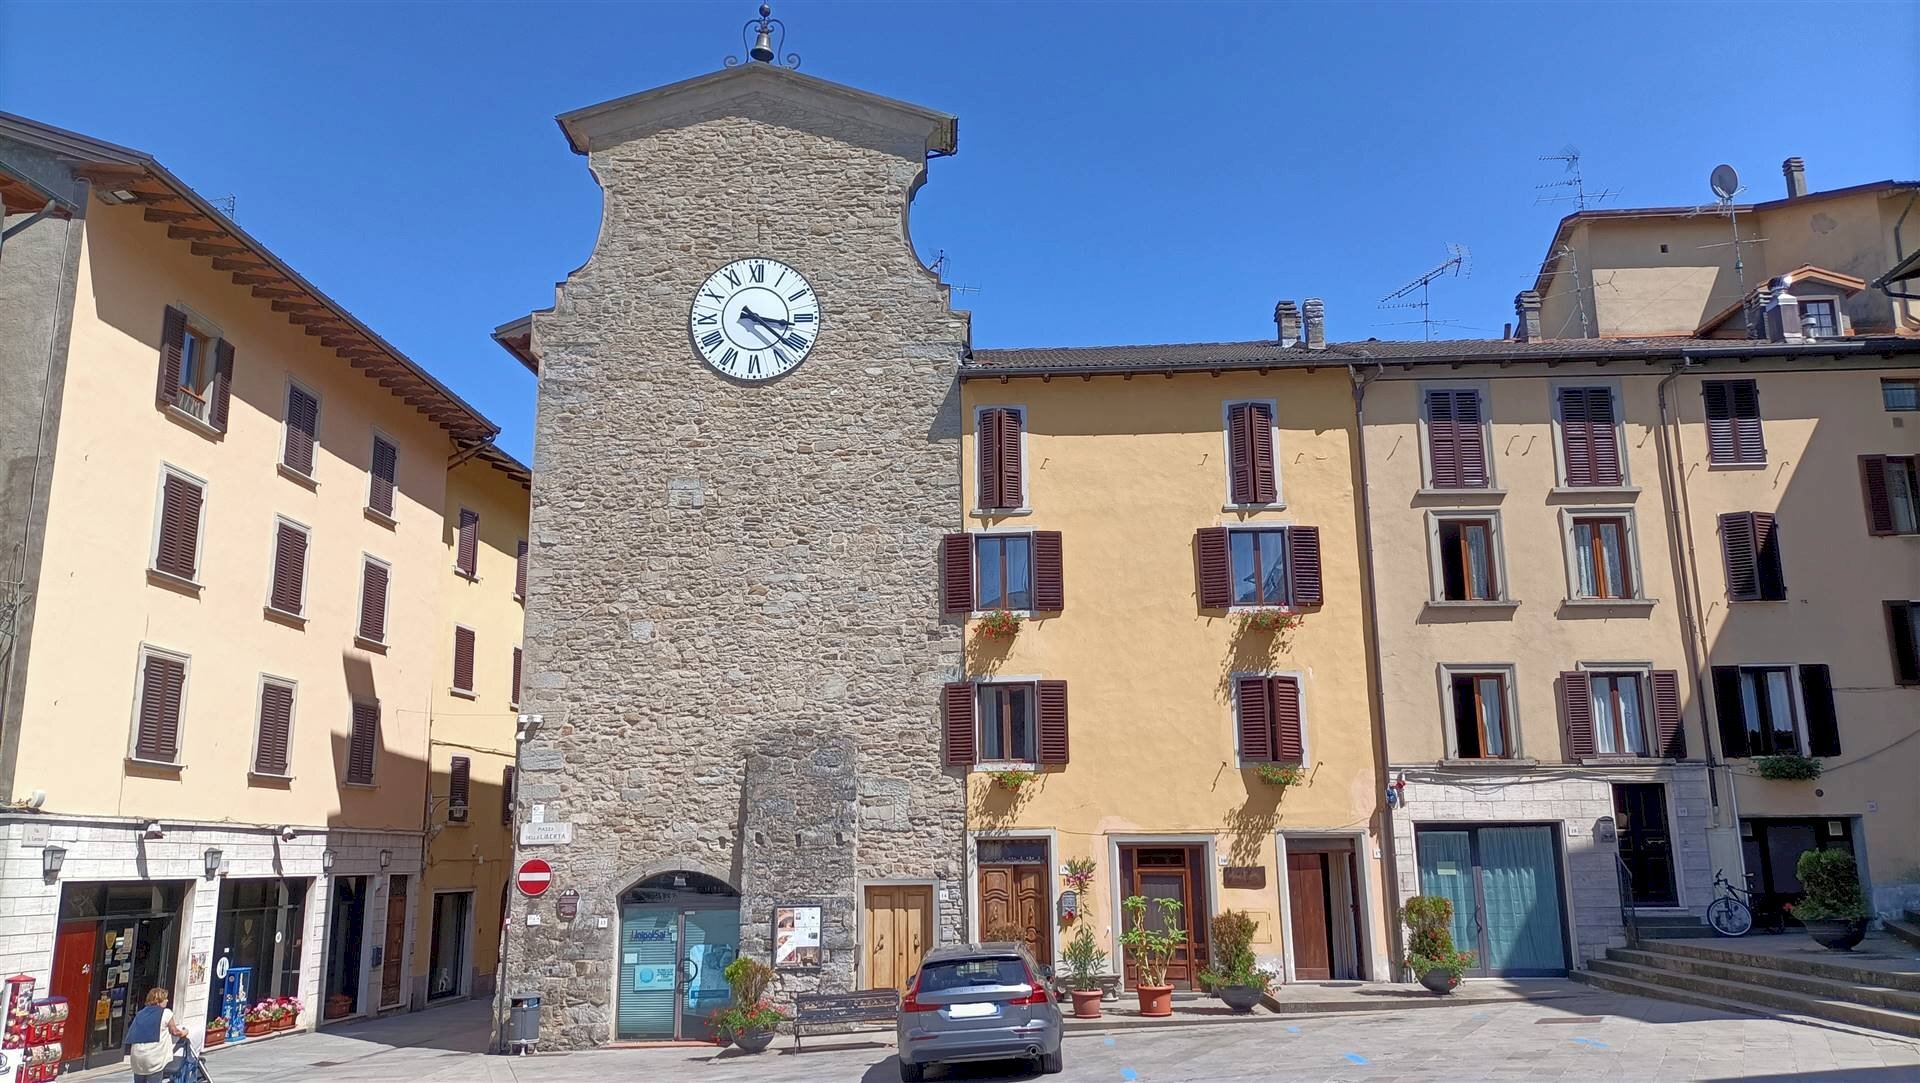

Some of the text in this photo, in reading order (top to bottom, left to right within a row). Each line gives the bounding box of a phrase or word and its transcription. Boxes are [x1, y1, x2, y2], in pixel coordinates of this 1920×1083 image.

[723, 269, 742, 290] XI
[749, 264, 764, 283] XII
[775, 271, 786, 288] I
[704, 288, 725, 304] X
[788, 289, 807, 302] II
[697, 313, 717, 325] IX
[794, 314, 813, 322] III
[701, 331, 725, 354] VIII
[719, 347, 739, 370] VII
[748, 354, 761, 374] VI
[773, 349, 788, 368] V
